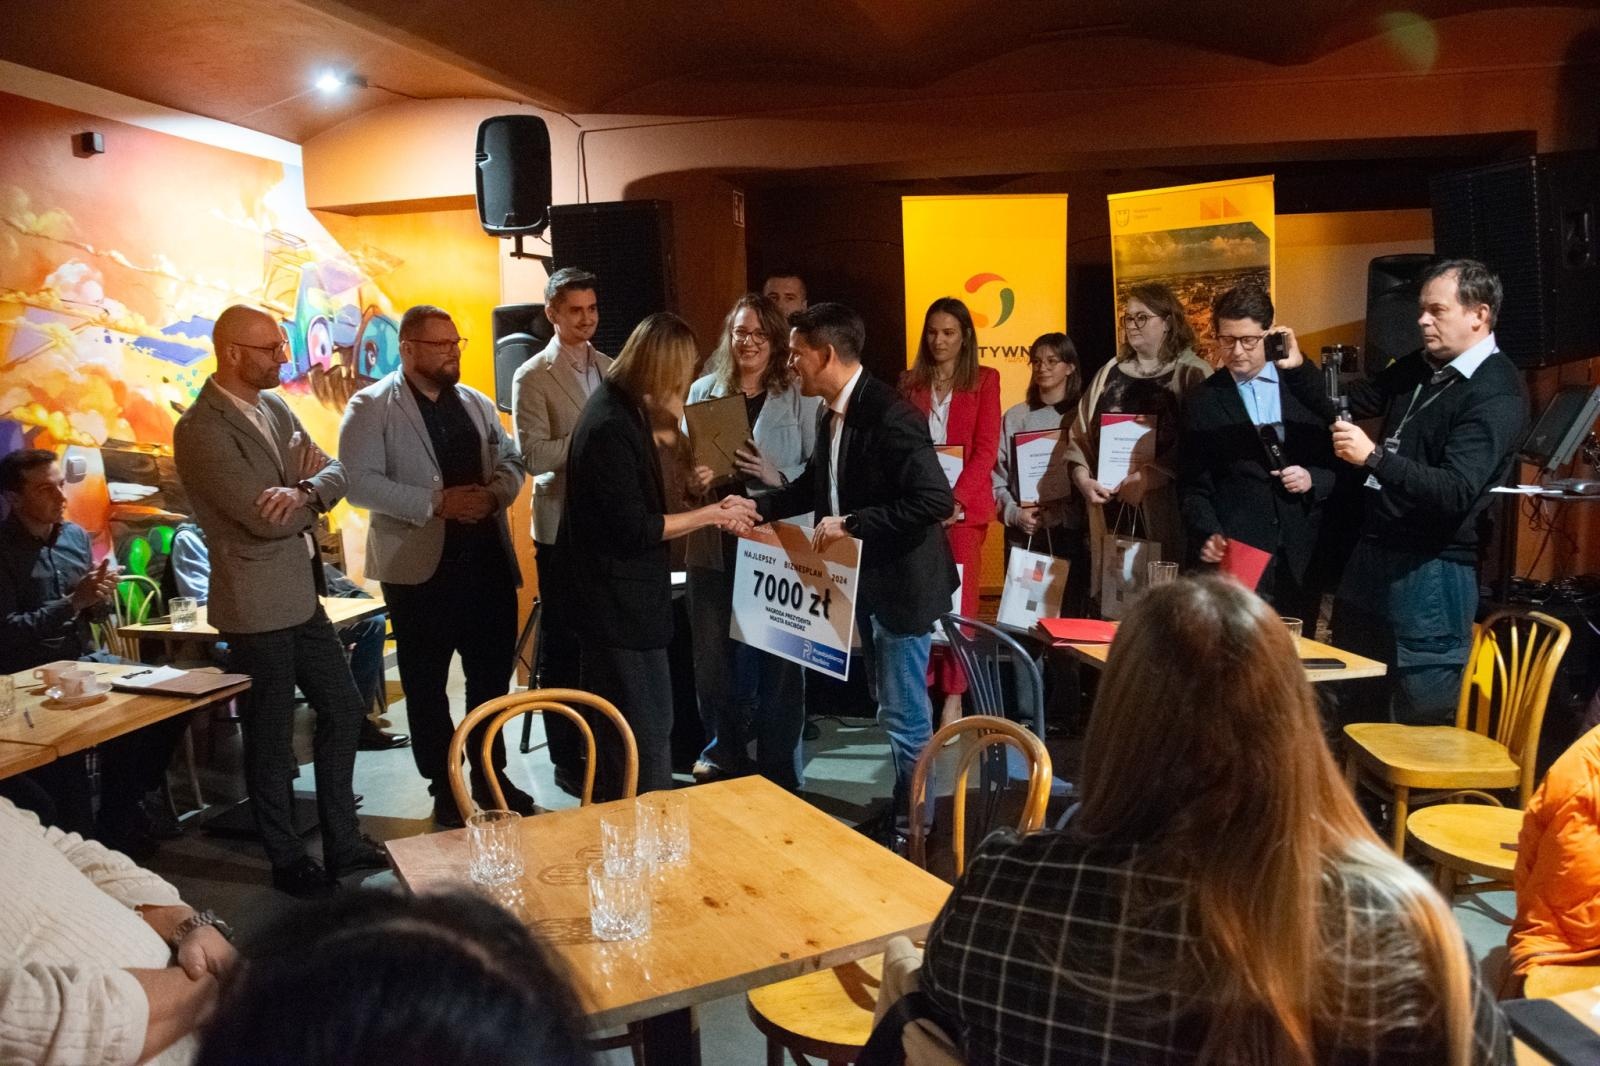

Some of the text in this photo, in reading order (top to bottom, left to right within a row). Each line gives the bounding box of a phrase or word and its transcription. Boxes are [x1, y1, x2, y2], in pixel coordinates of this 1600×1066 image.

[743, 550, 848, 585] NAJLEPSZY BIZNESPLAN 2024
[753, 569, 833, 620] 7000 zł
